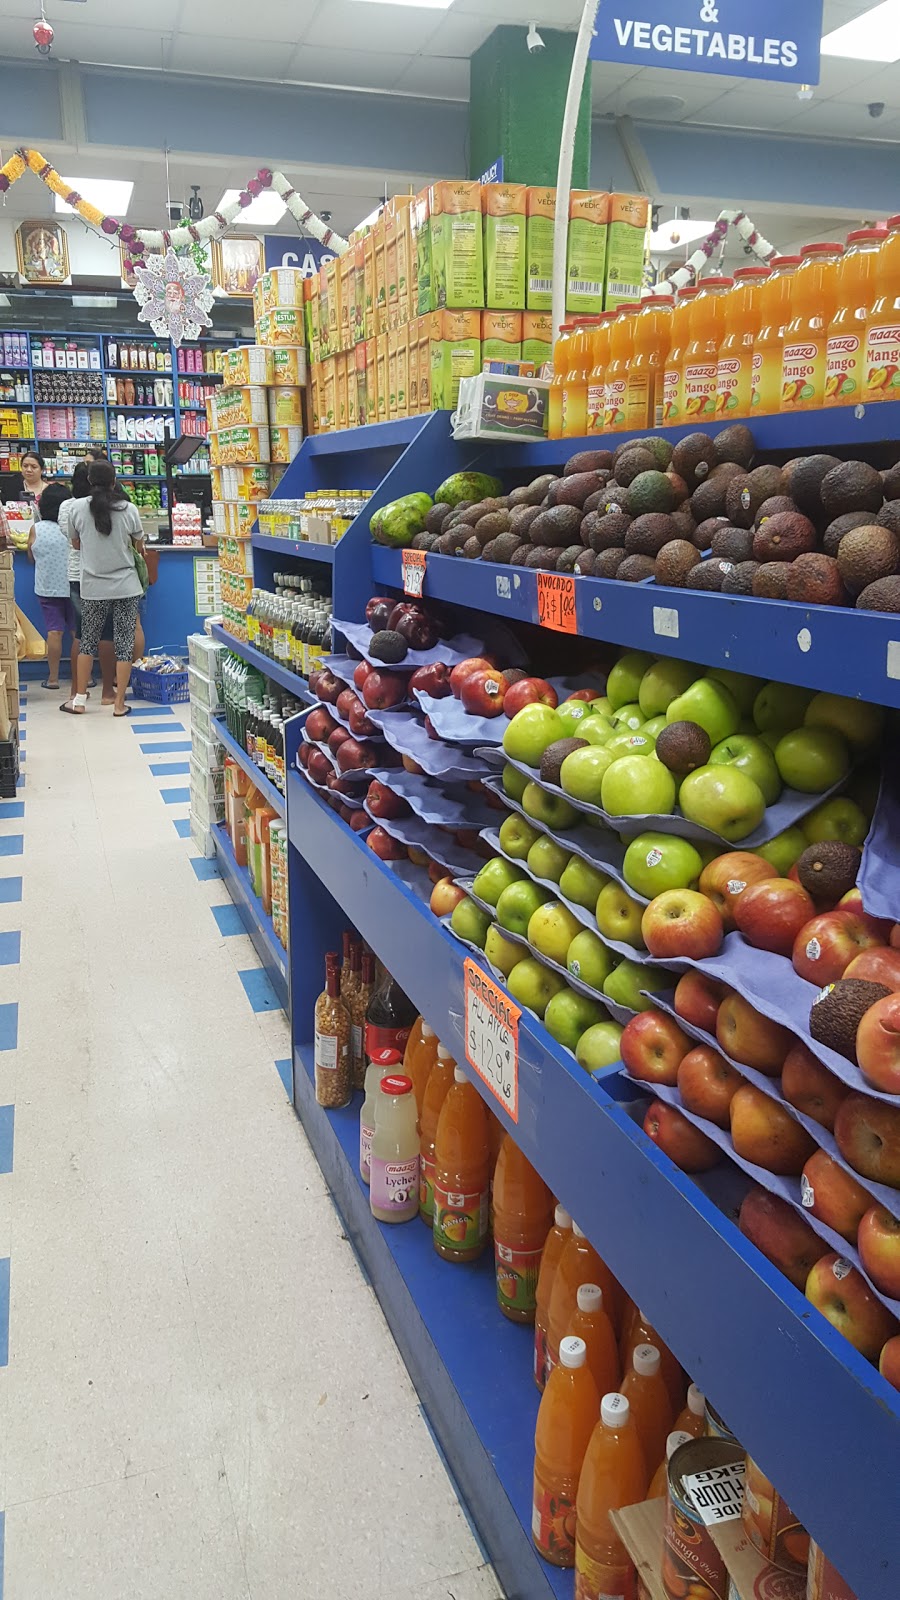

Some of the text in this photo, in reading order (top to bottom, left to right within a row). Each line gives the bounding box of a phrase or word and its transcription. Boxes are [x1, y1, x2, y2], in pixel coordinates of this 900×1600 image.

[700, 0, 719, 23] &
[613, 18, 798, 67] VEGETABLES
[784, 347, 814, 357] maaza
[866, 349, 900, 363] Mang
[686, 367, 716, 377] maaza
[684, 383, 717, 394] Mango
[718, 378, 739, 390] ango
[605, 397, 625, 407] ango
[537, 573, 573, 593] AVOCADO
[538, 591, 546, 624] 2
[468, 968, 514, 1031] SPECIAL
[388, 1162, 416, 1172] maaza
[385, 1174, 417, 1188] Lychee
[440, 1216, 469, 1231] MANGO
[712, 1504, 743, 1519] IDE
[665, 1525, 700, 1562] Mango
